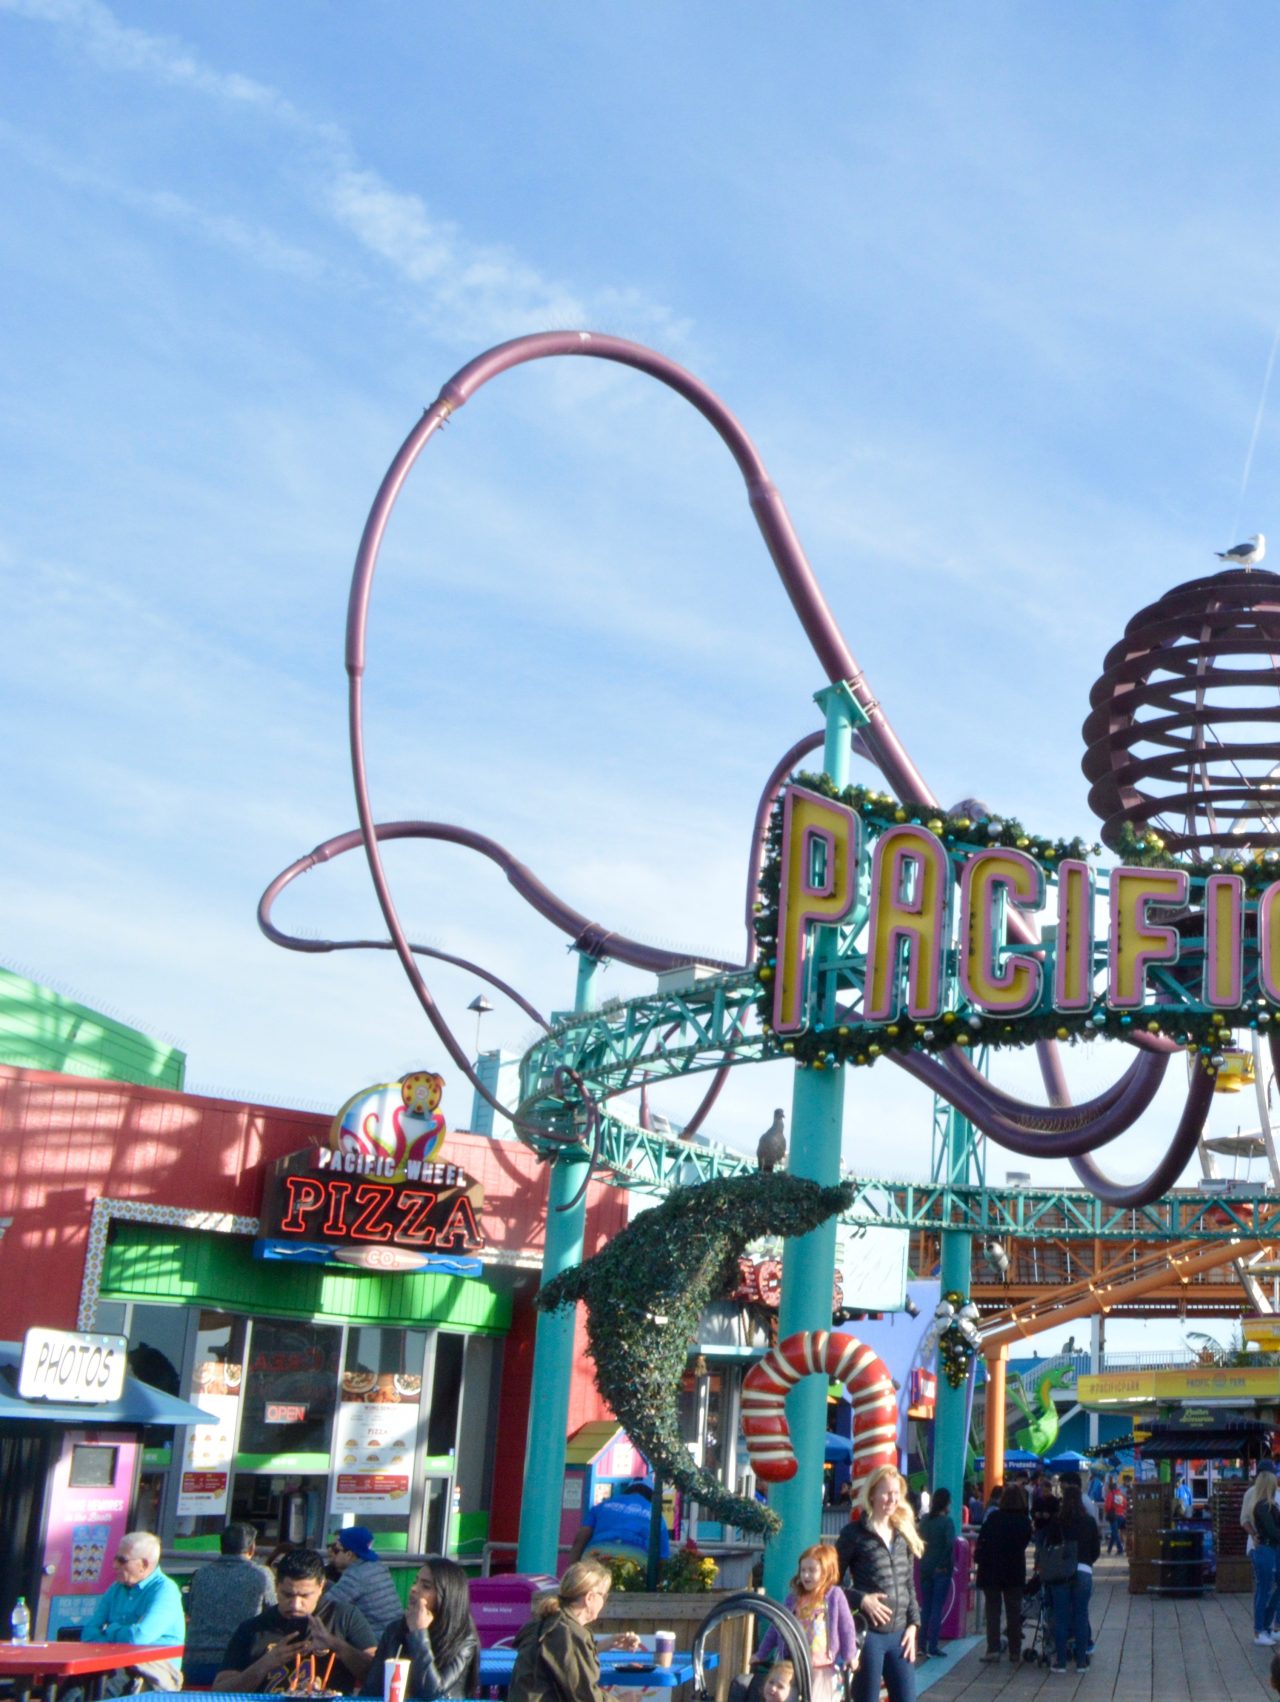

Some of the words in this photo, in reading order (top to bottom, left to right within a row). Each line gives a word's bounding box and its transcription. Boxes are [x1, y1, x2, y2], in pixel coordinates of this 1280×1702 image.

[318, 1147, 396, 1177] PACIFIC
[407, 1159, 467, 1187] WHEEL
[281, 1176, 484, 1249] PIZZA
[366, 1250, 398, 1266] CO.
[33, 1341, 115, 1388] PHOTOS
[267, 1405, 306, 1421] OPEN
